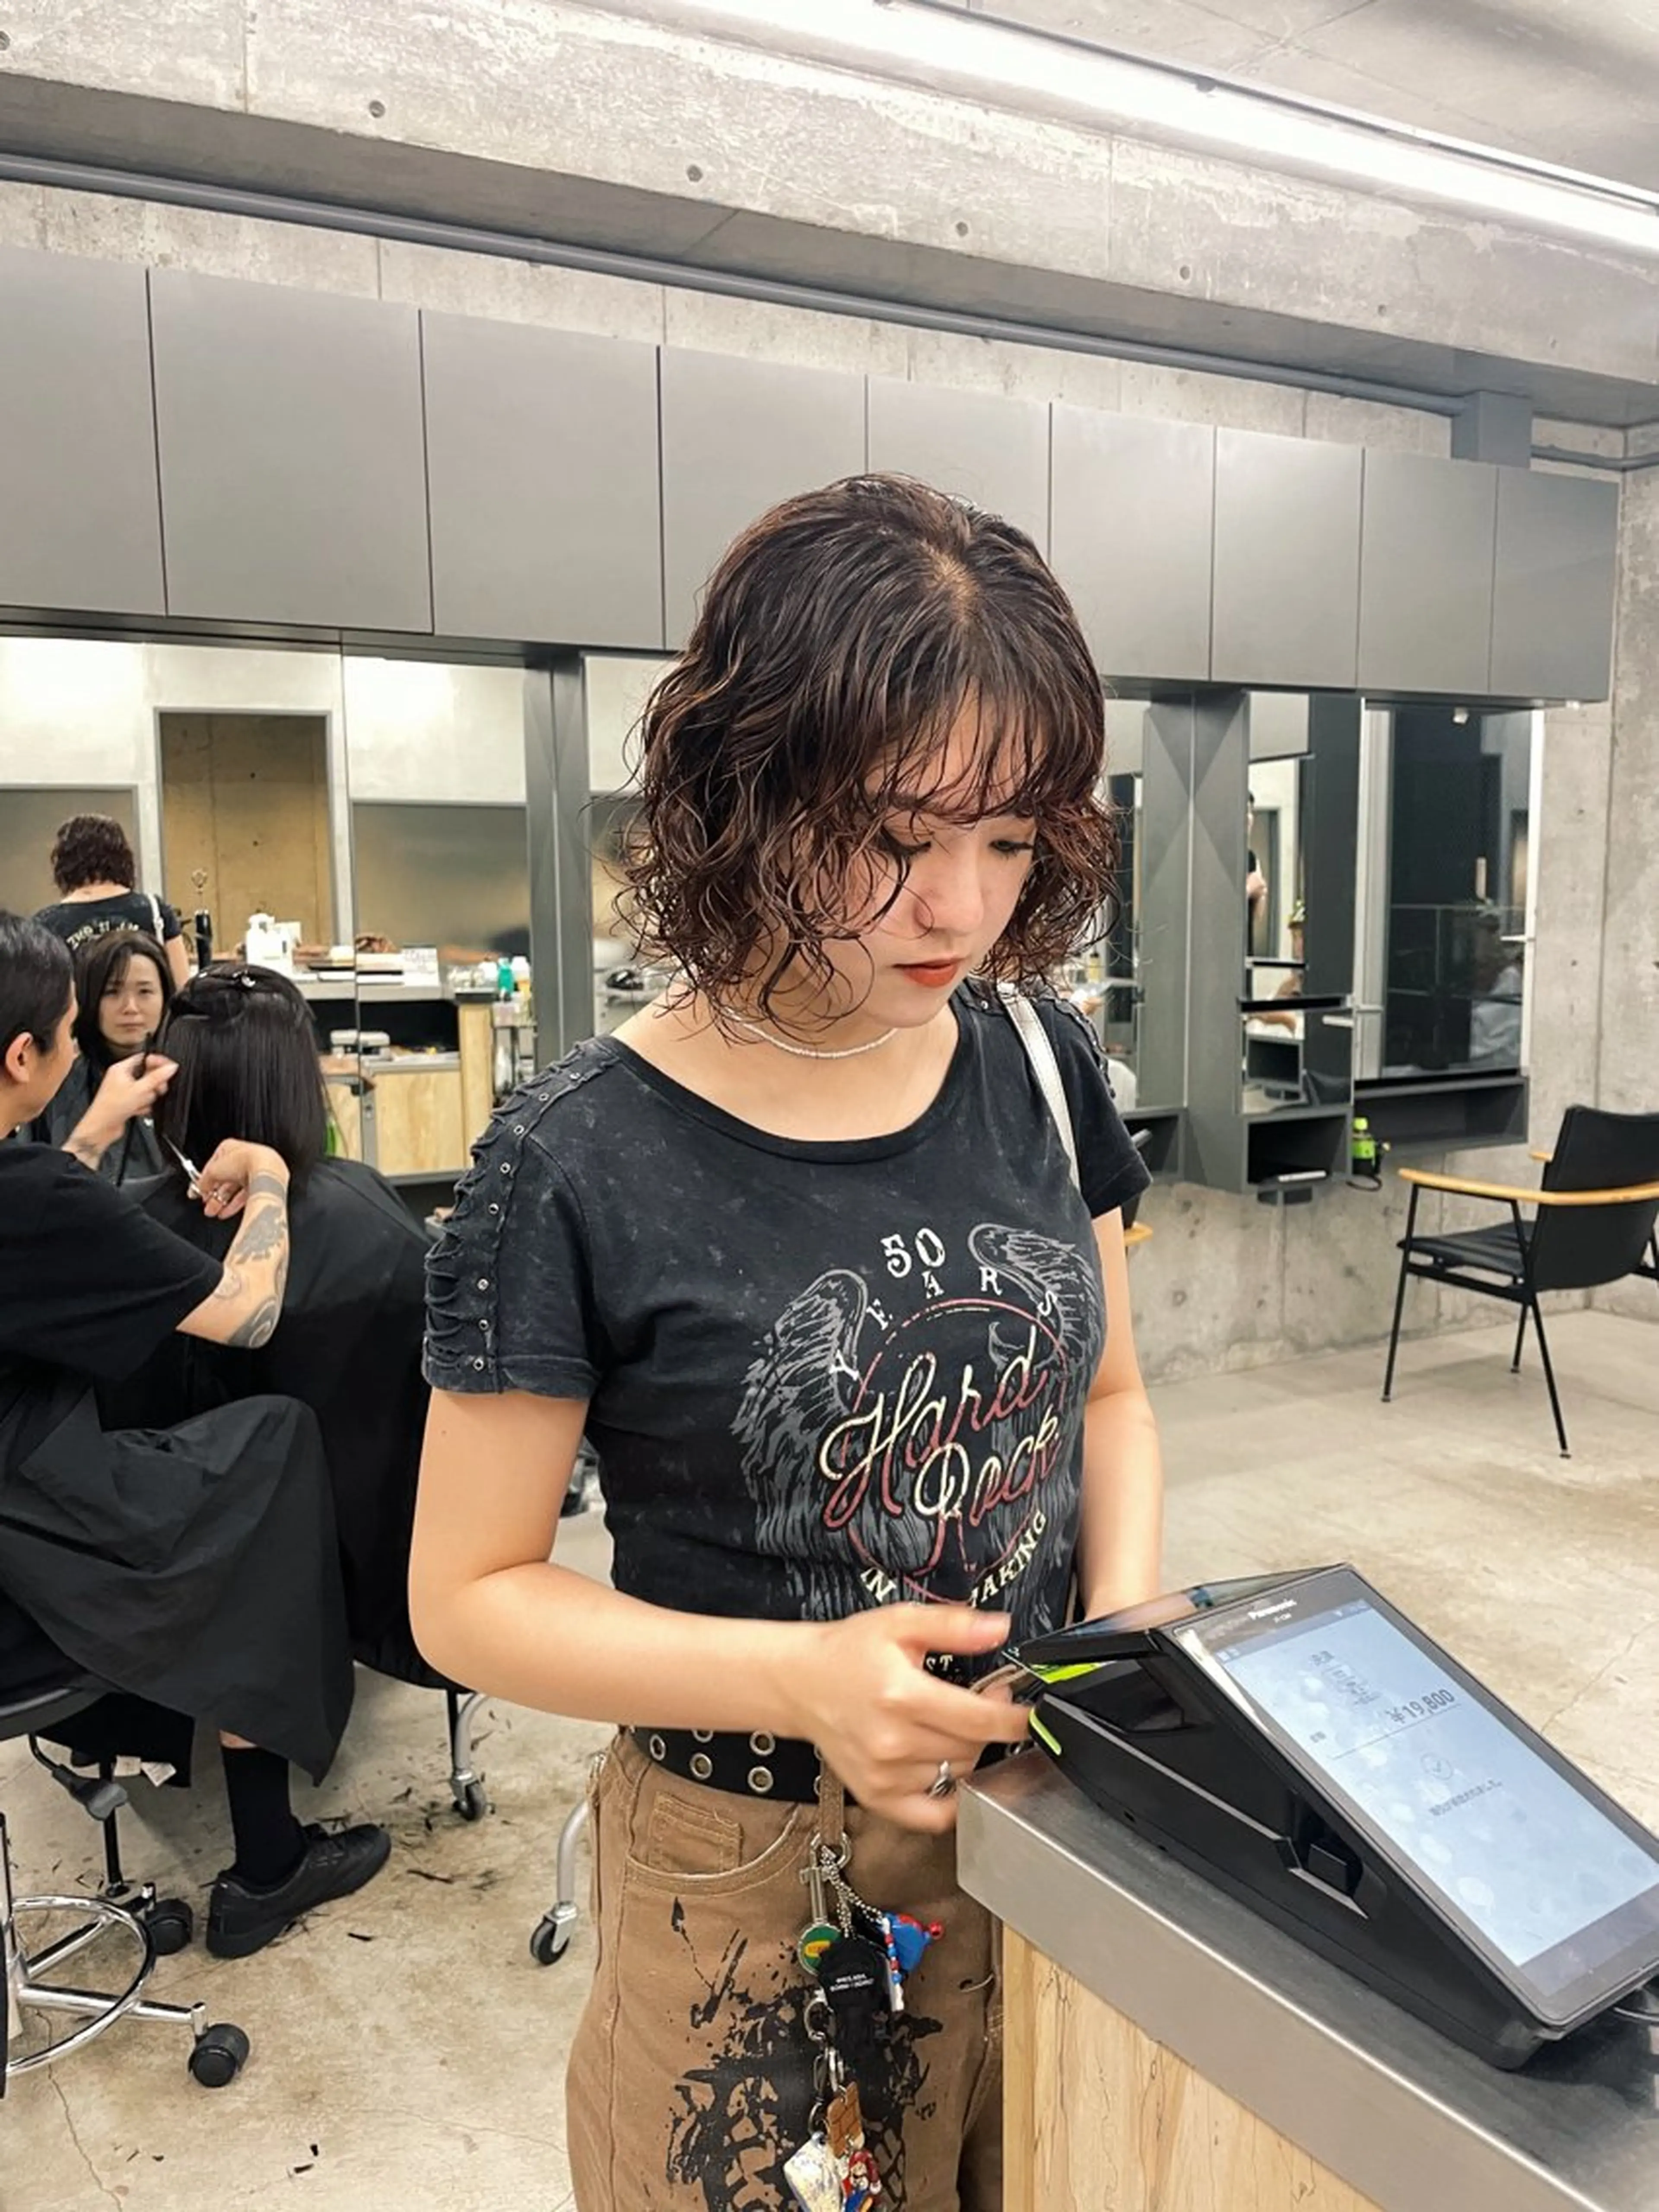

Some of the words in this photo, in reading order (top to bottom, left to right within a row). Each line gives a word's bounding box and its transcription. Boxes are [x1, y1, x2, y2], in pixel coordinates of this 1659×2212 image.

[880, 1227, 946, 1278] 50
[829, 1266, 1057, 1381] YEARS
[820, 1324, 1049, 1528] Hard
[1384, 1688, 1456, 1724] ¥19,800
